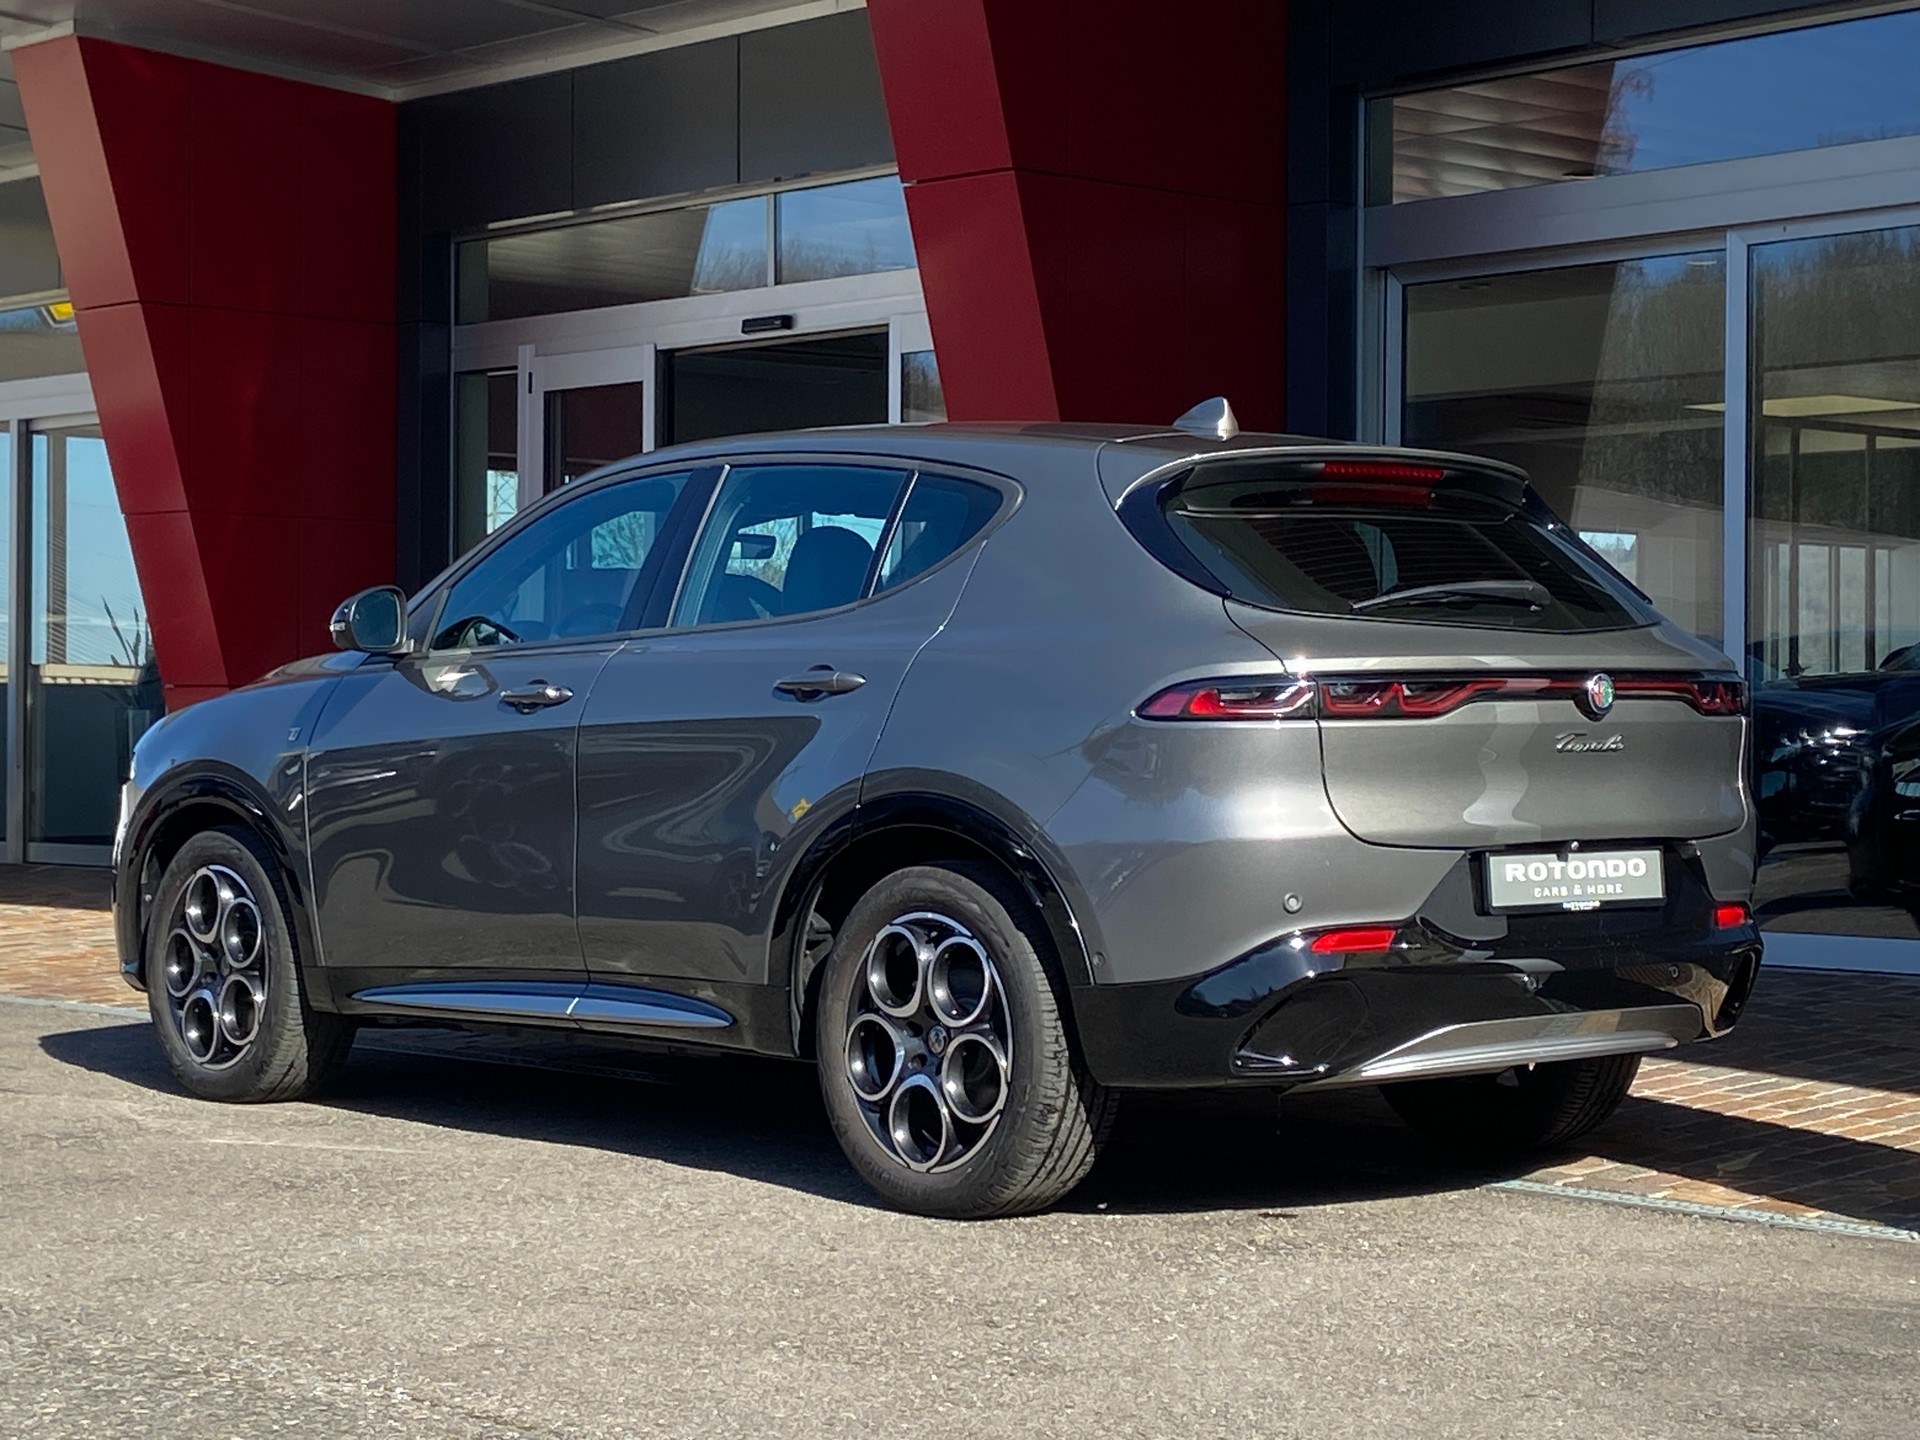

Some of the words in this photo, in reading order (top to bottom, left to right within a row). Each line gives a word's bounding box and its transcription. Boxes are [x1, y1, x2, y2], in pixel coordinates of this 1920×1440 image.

[1505, 858, 1646, 882] ROTONDO
[1534, 886, 1568, 897] CARS
[1573, 885, 1582, 896] &
[1587, 884, 1623, 895] MORE
